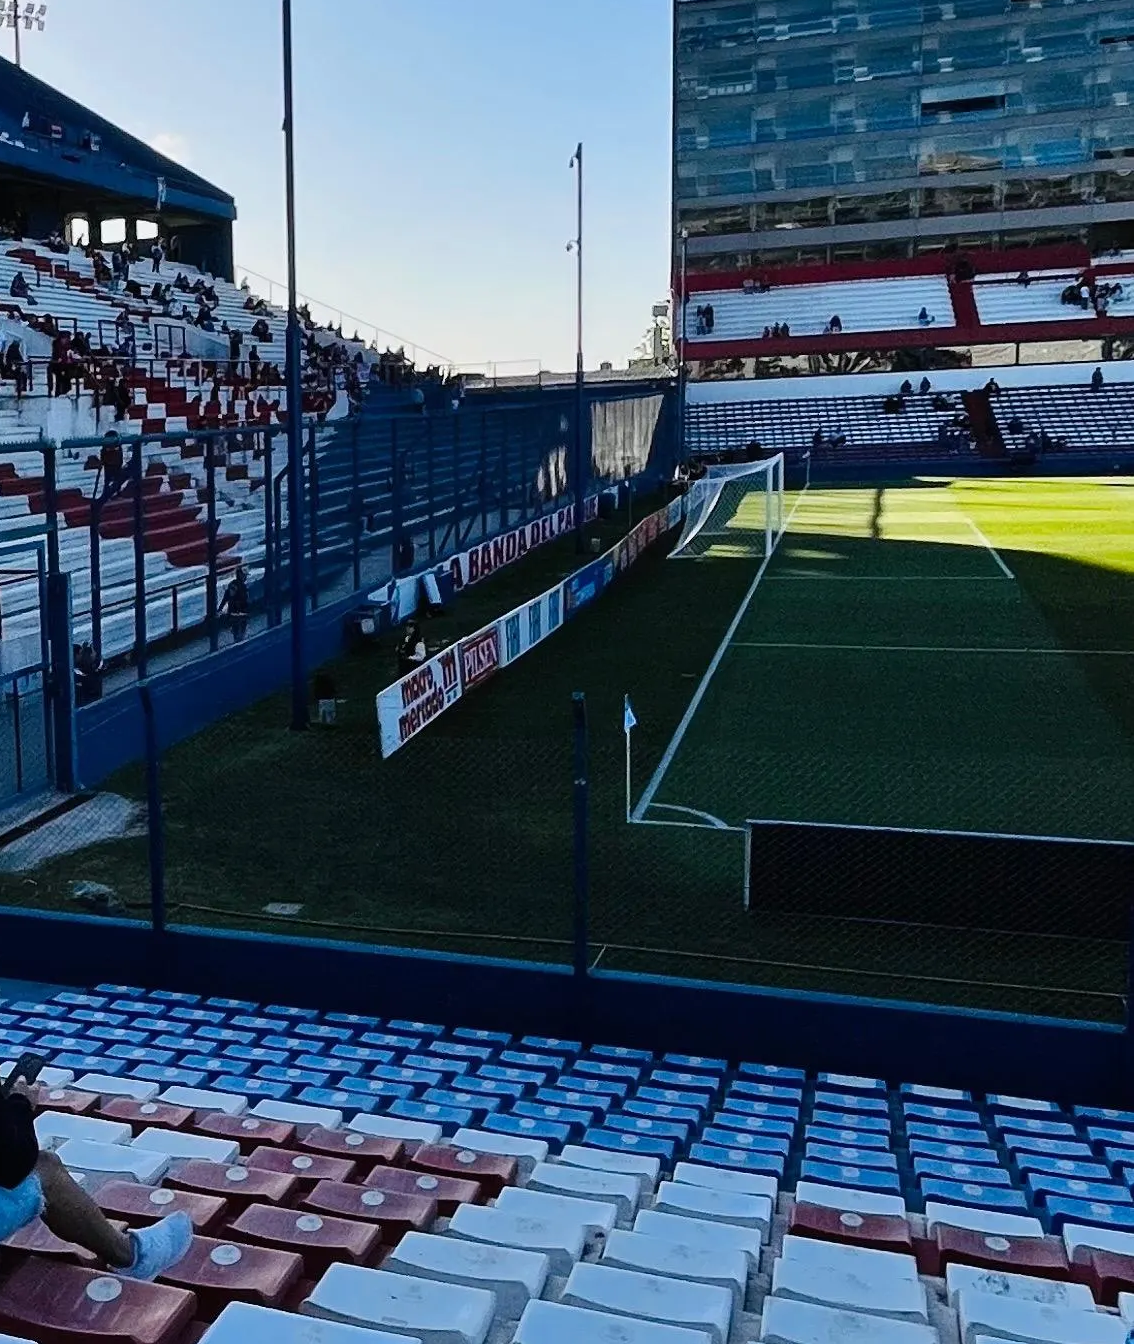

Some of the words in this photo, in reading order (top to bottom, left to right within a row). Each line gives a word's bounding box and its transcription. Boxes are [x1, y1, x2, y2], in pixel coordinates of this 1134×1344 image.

[468, 527, 528, 580] BANDA
[530, 516, 555, 546] DEL
[464, 636, 498, 682] PILSEN
[399, 684, 445, 742] mercado
[401, 665, 434, 709] macro
